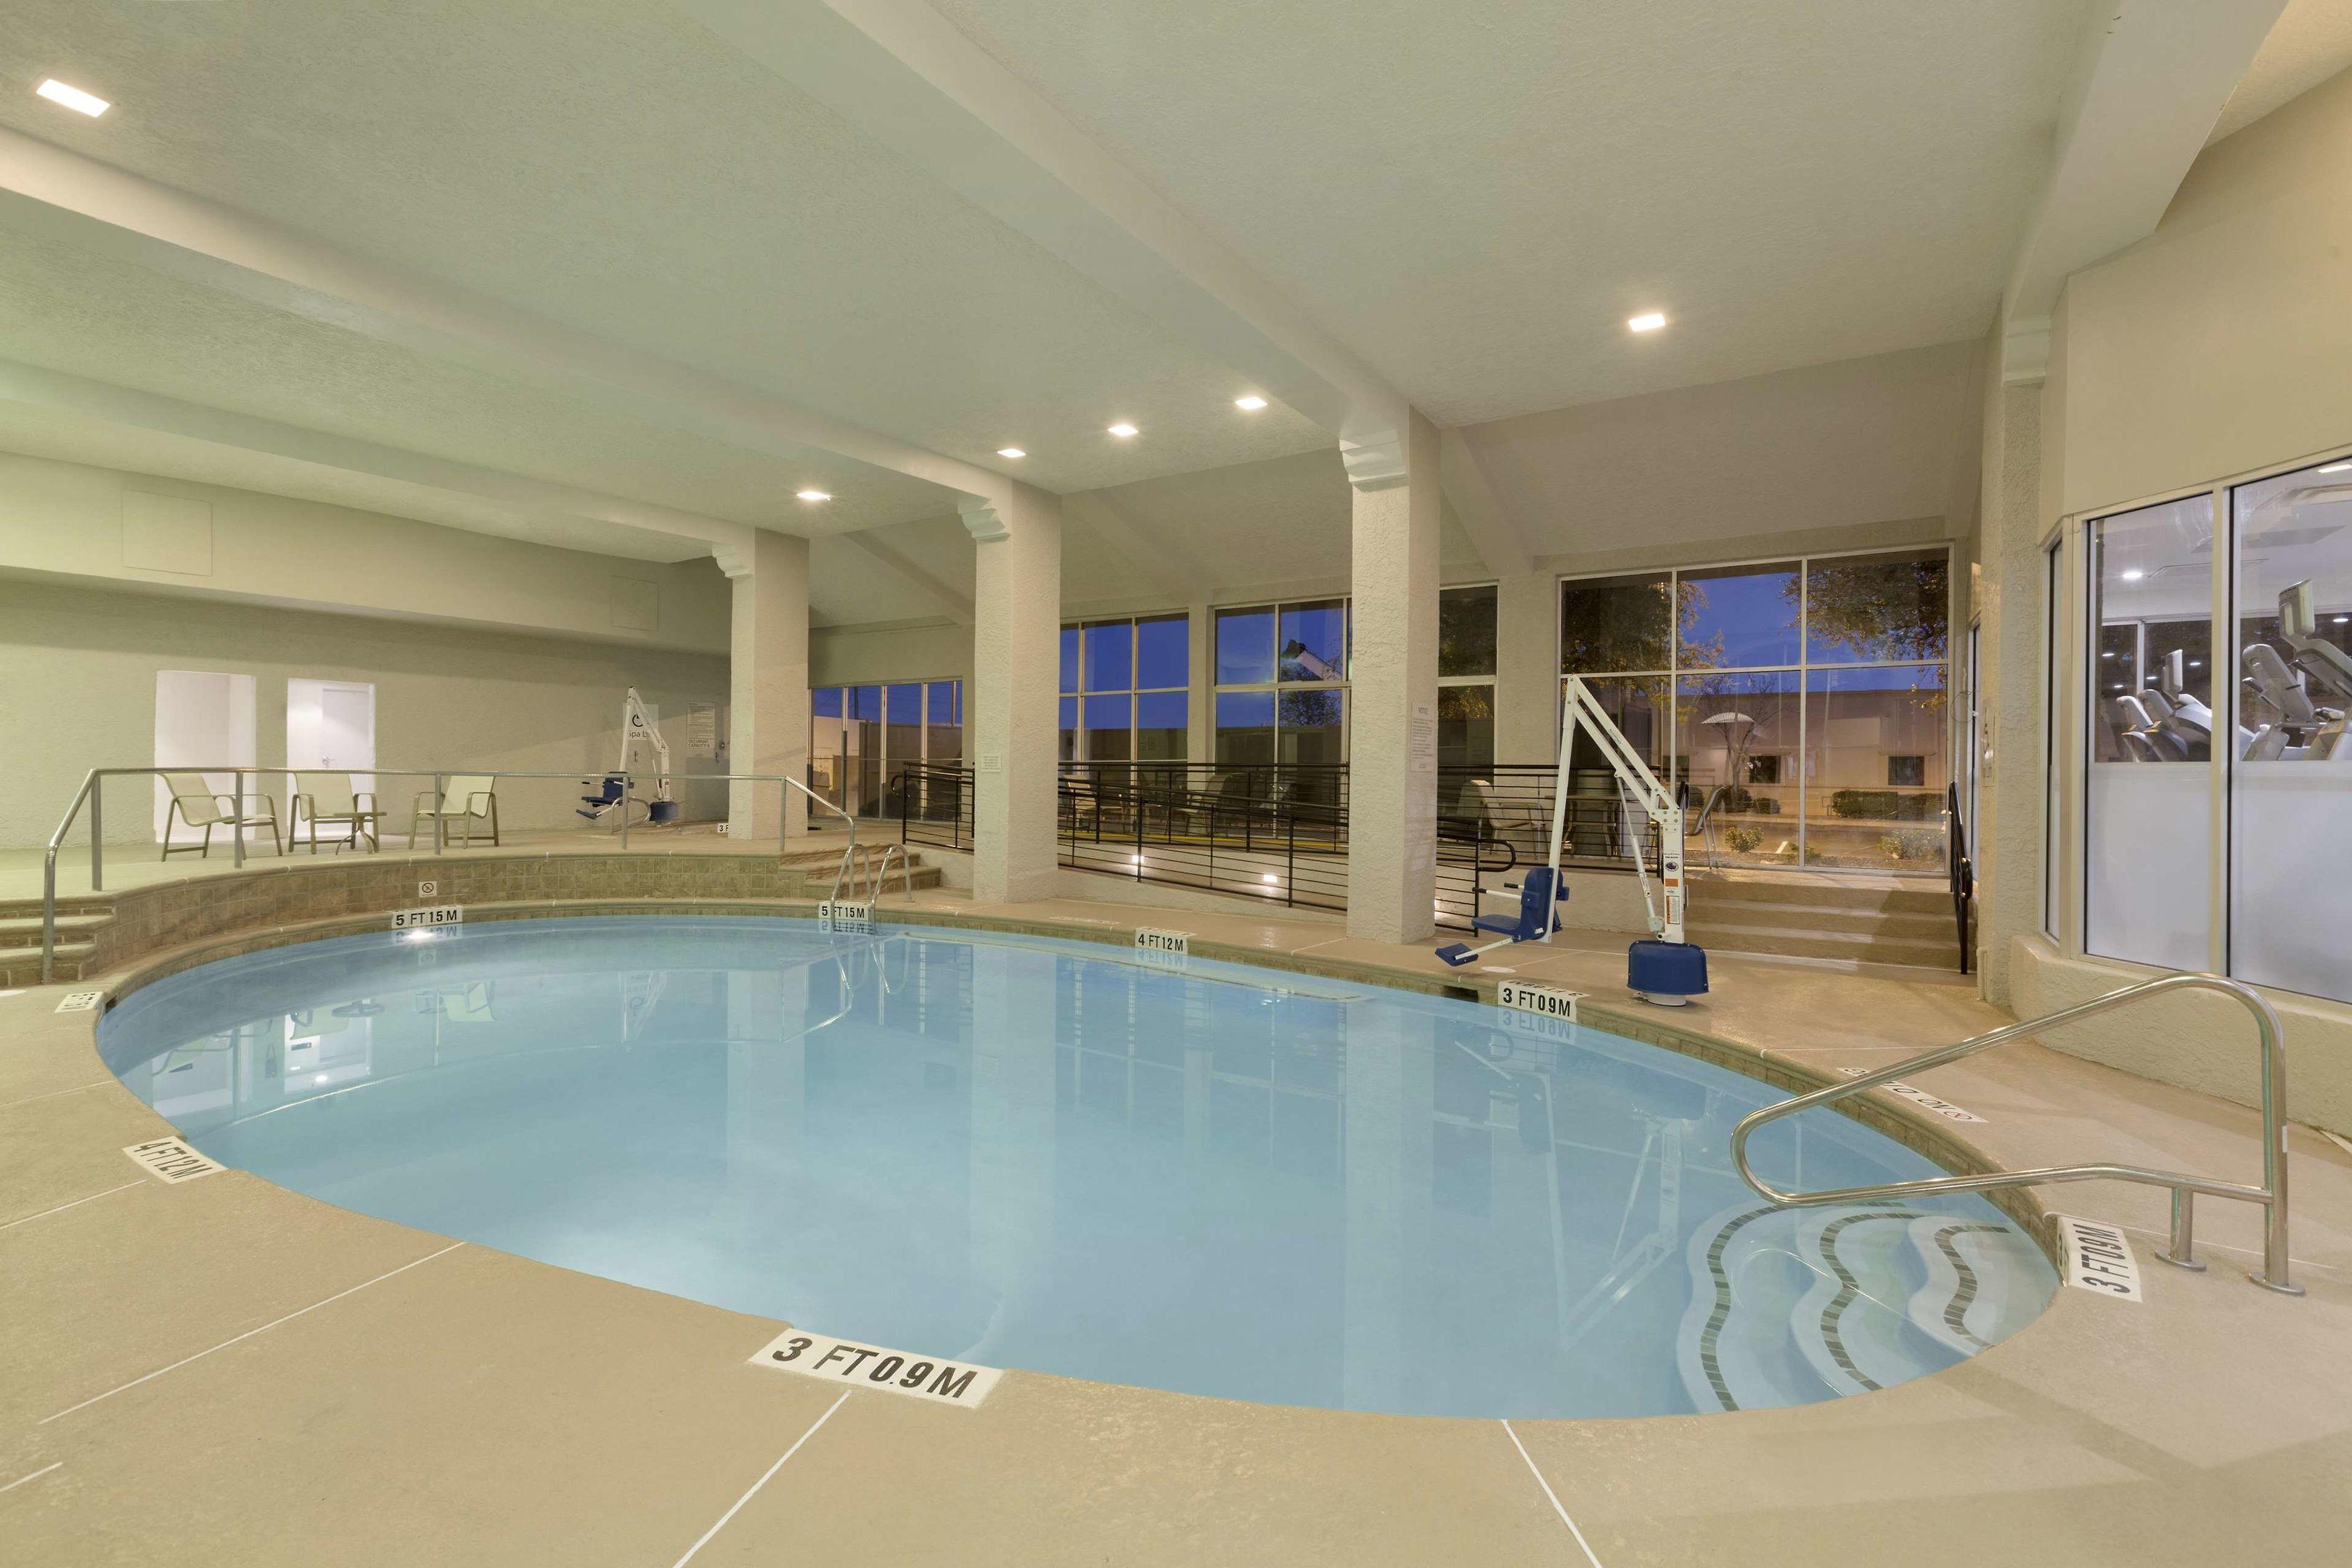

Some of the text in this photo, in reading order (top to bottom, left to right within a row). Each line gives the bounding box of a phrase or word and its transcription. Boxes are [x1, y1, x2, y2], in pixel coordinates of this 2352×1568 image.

[396, 915, 404, 926] 5
[410, 912, 425, 925] FT
[446, 910, 457, 921] M
[822, 906, 828, 916] 5
[857, 907, 865, 918] M
[1138, 934, 1145, 945] 4
[1149, 935, 1159, 947] FT
[1175, 939, 1183, 951] M
[1503, 988, 1512, 1003] 3
[1519, 990, 1535, 1008] FT
[1559, 999, 1570, 1017] M
[134, 1141, 172, 1152] 4
[140, 1146, 187, 1161] FT
[2073, 1223, 2120, 1242] M
[2081, 1254, 2130, 1278] FT
[2082, 1276, 2131, 1293] 3
[772, 1337, 979, 1398] 3 FT 0.9 M
